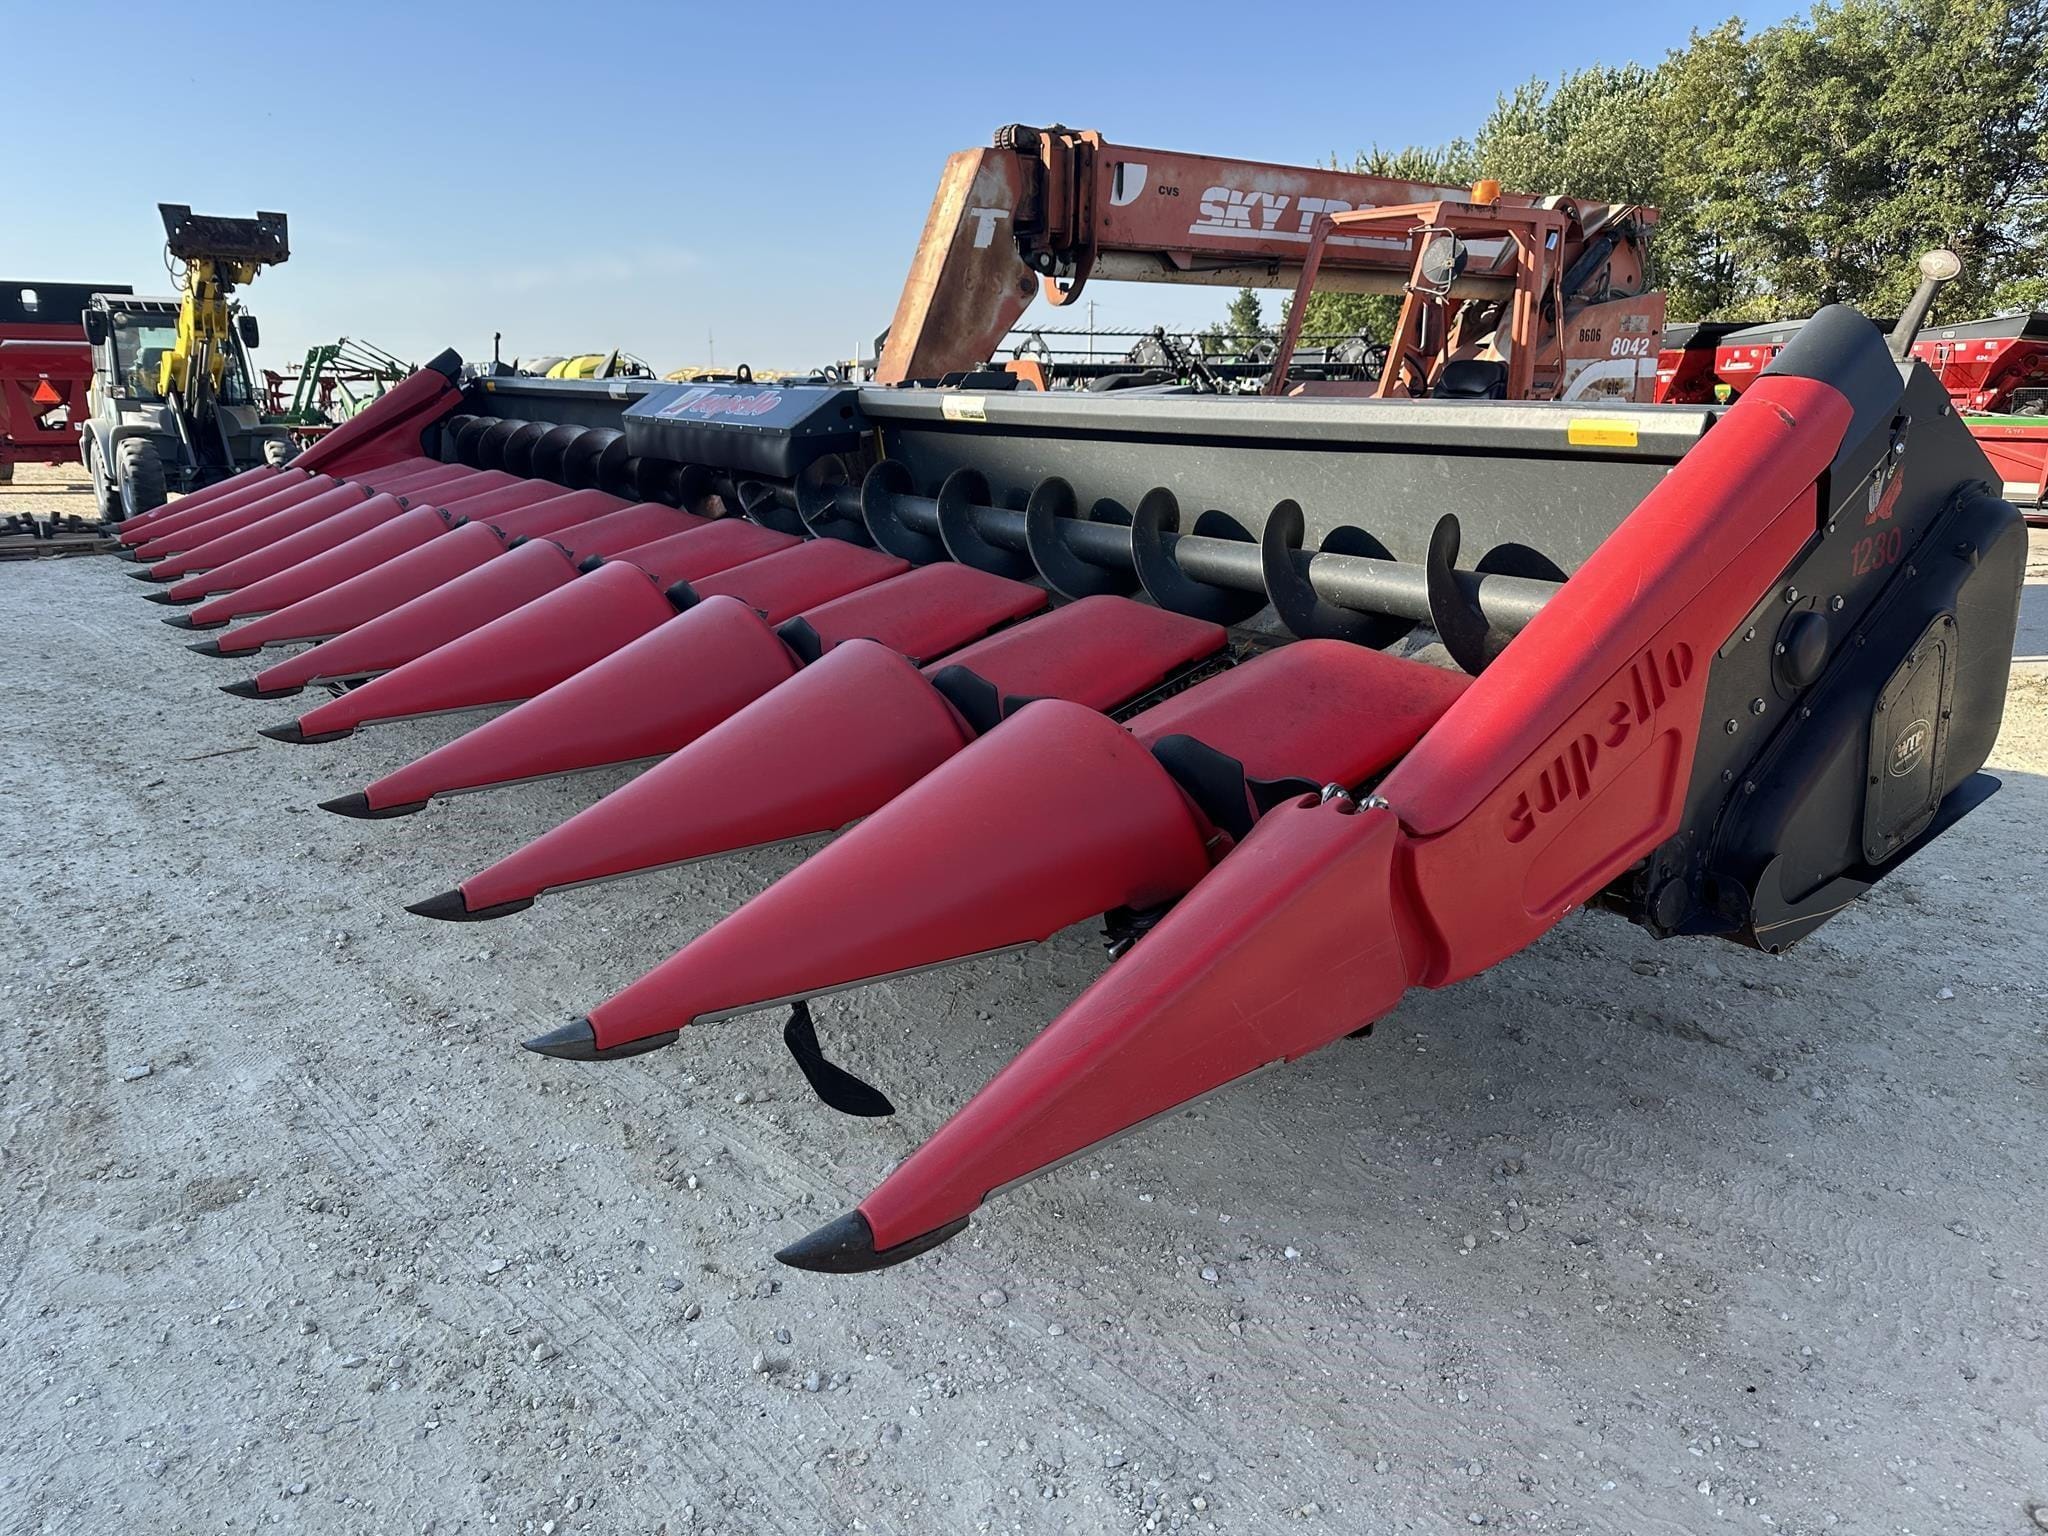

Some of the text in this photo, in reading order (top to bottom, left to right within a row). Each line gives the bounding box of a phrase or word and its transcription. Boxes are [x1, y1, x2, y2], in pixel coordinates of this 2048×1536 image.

[1158, 185, 1180, 197] CVS
[1196, 186, 1290, 230] SKY
[970, 207, 1010, 249] T
[1610, 336, 1650, 356] 8042
[1850, 526, 1902, 577] 1230
